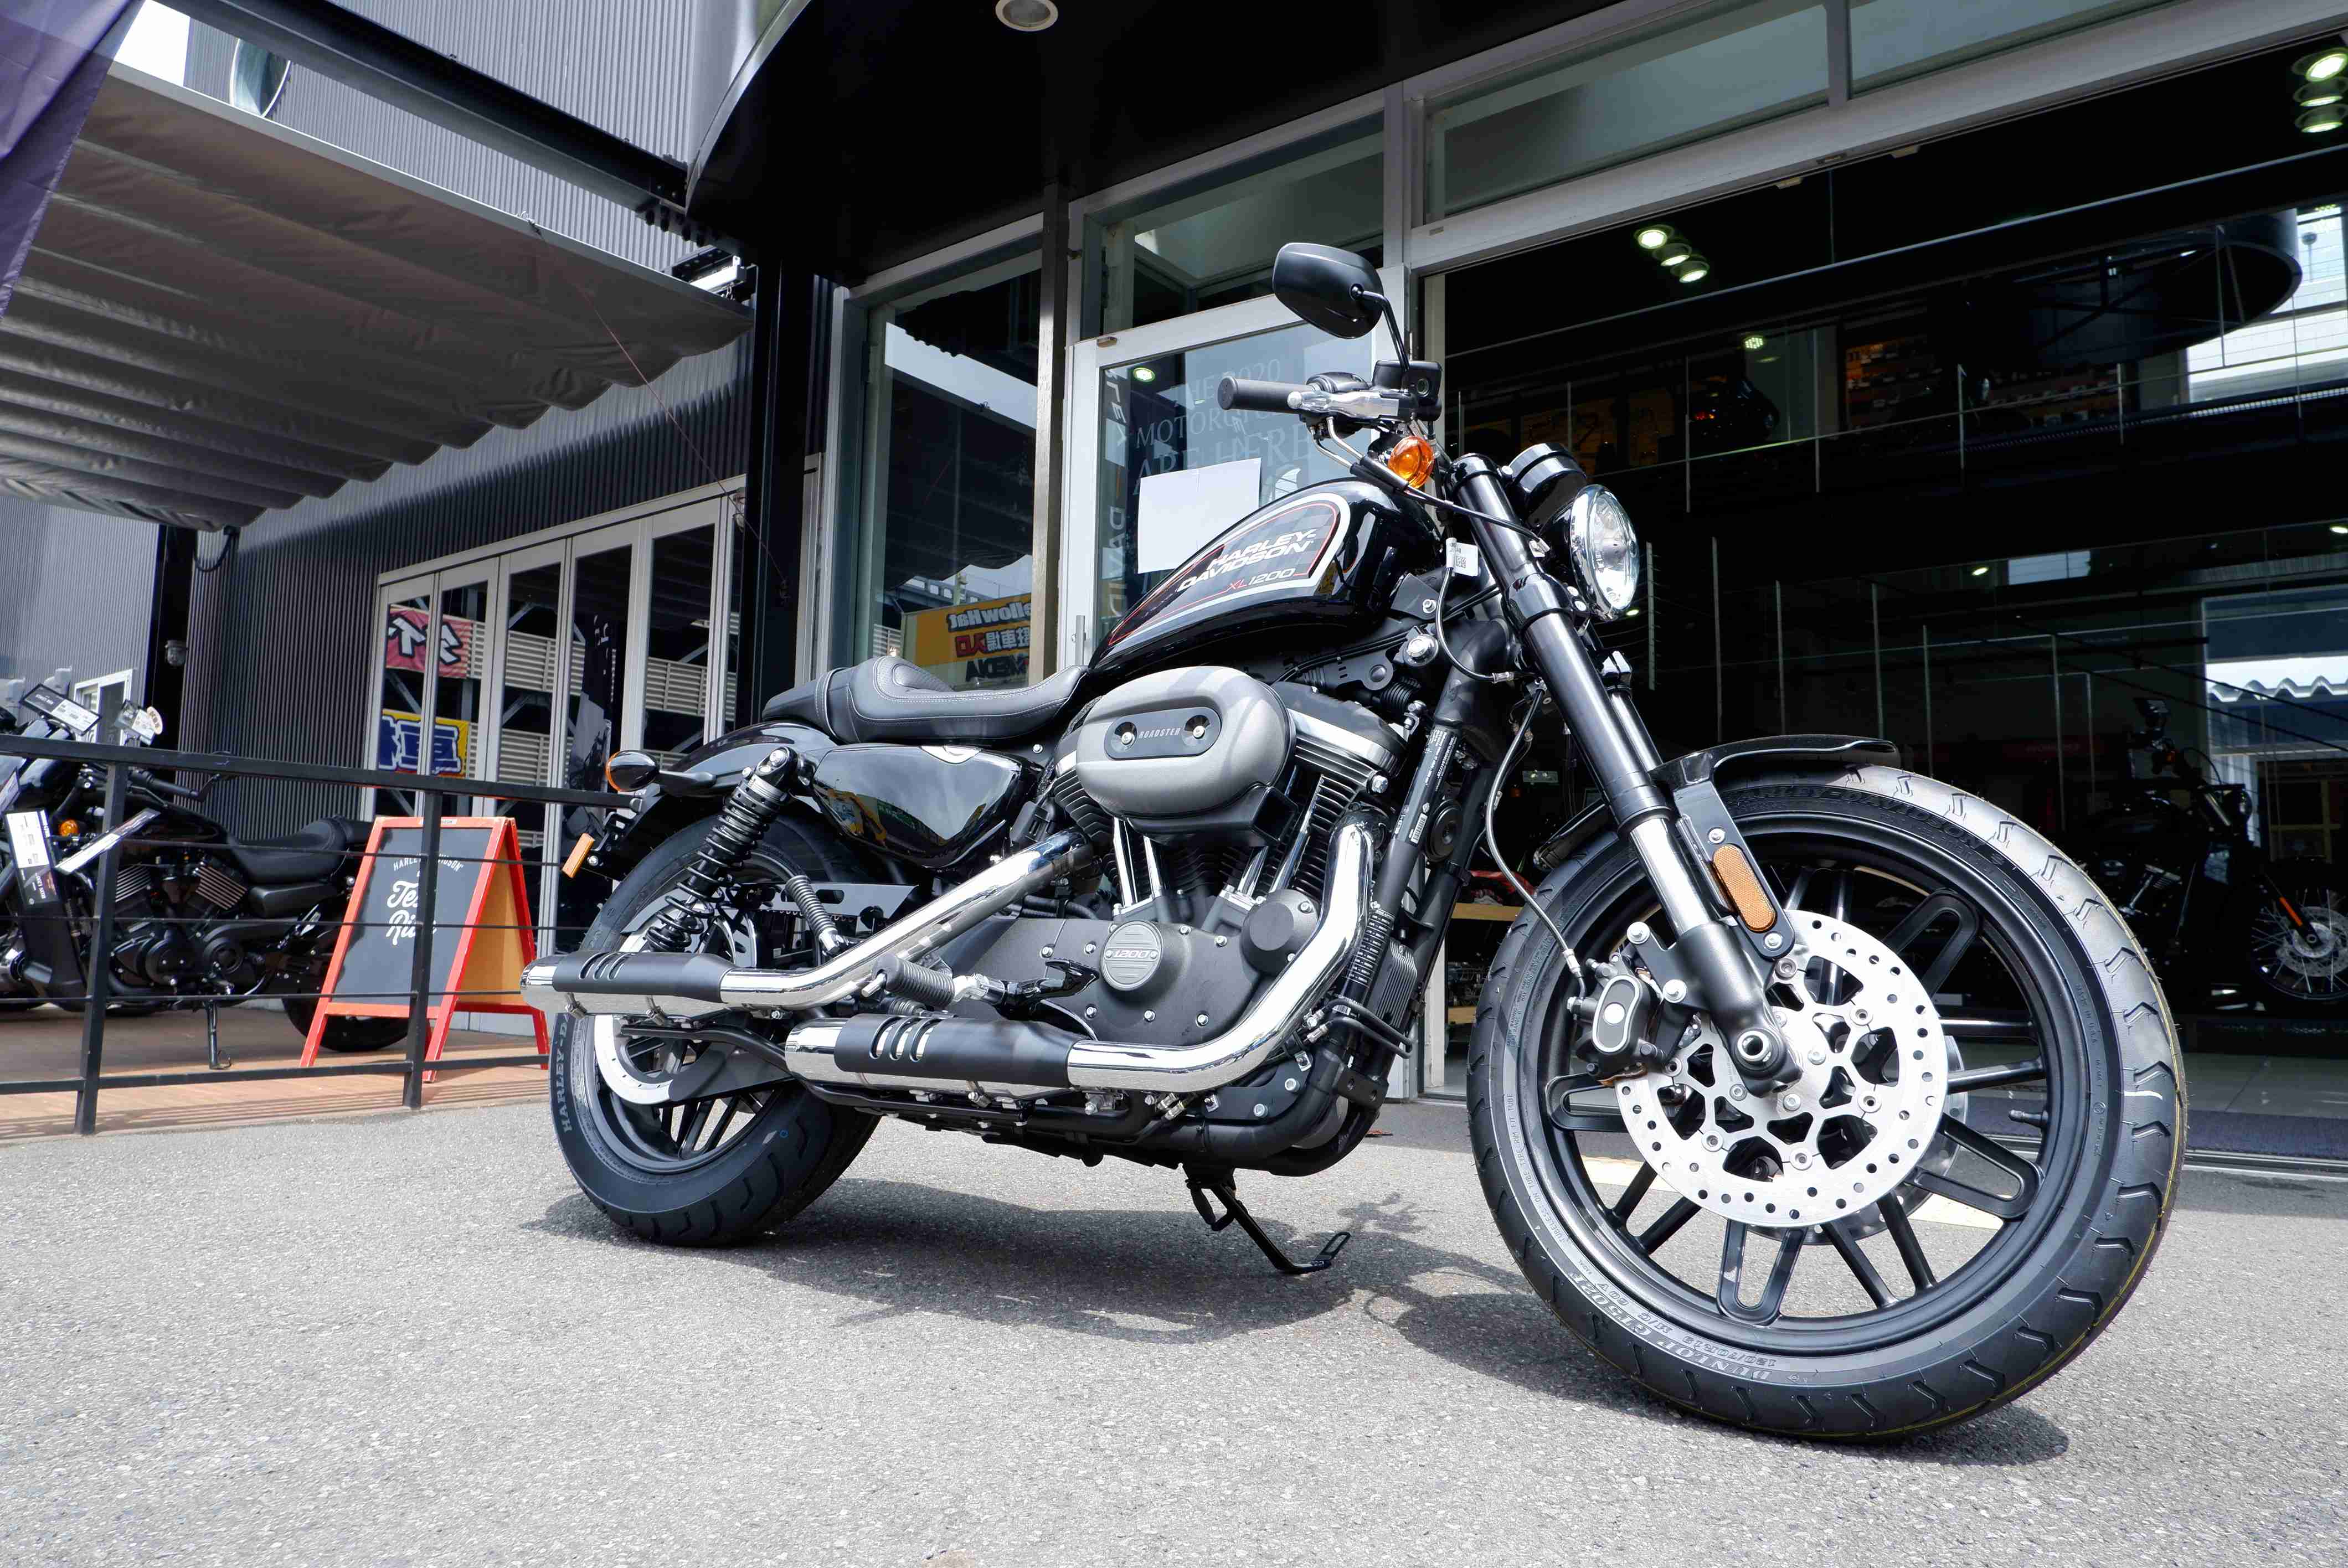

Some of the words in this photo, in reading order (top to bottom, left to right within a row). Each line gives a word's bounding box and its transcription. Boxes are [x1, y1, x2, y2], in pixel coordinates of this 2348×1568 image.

[1176, 540, 1312, 592] DAVIDSON
[1138, 727, 1182, 740] ROADSTER
[1111, 948, 1152, 958] 1200
[1512, 1131, 1521, 1146] RIM
[1656, 1340, 1770, 1380] DUNLOP
